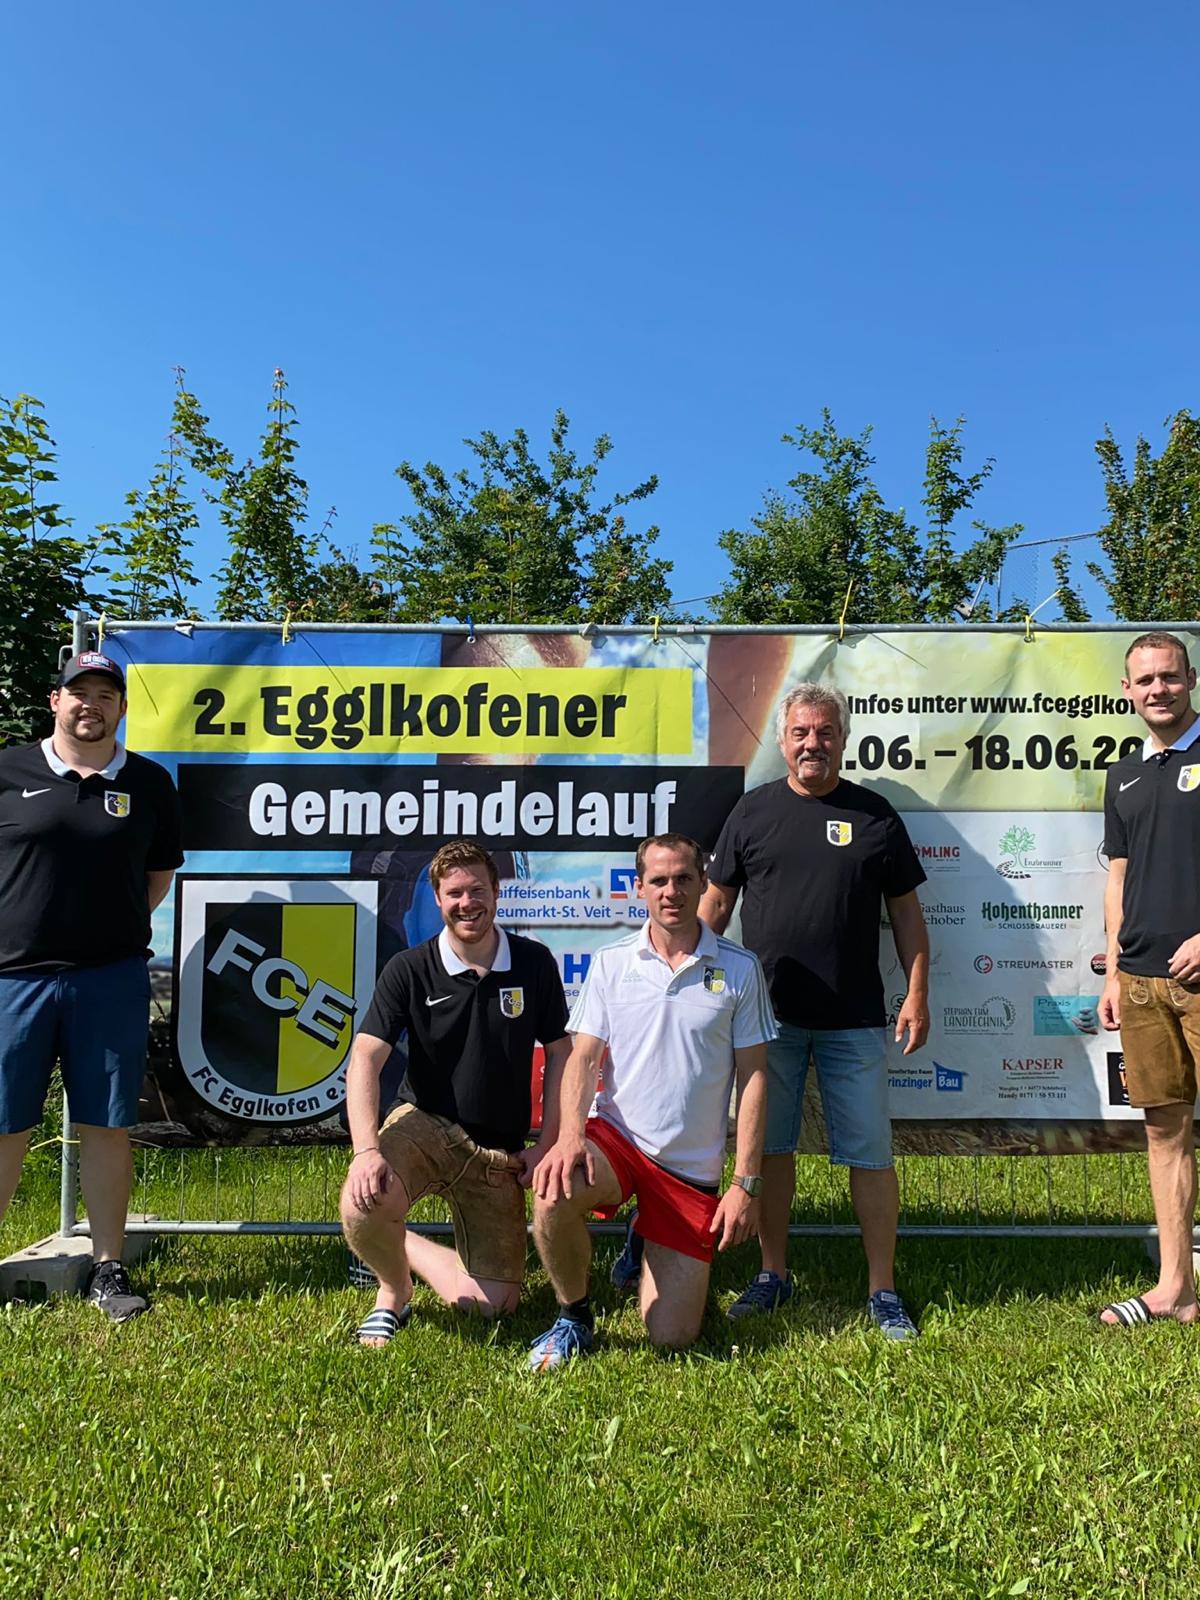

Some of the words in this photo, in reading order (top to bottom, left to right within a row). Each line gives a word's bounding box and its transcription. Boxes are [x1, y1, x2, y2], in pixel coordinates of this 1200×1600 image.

[847, 693, 904, 715] Infos
[908, 695, 968, 714] unter
[193, 688, 246, 736] 2.
[260, 683, 627, 750] Egglkofener
[839, 734, 927, 771] .06.
[964, 734, 1145, 771] 18.06.20
[249, 779, 677, 838] Gemeindelauf
[911, 843, 960, 859] ÖMLING
[498, 885, 591, 900] aiffeisenbank
[496, 905, 580, 919] eumarkt-St.
[584, 905, 611, 918] Veit
[628, 905, 650, 919] Rei
[981, 901, 1084, 922] Hohenthanner
[923, 914, 967, 926] chober
[997, 922, 1068, 930] SCHLOSSBRAUEREI
[996, 960, 1074, 969] STREUMASTER
[206, 927, 358, 1050] FCE
[1037, 998, 1072, 1007] Praxis
[943, 1016, 1006, 1028] LANDTECHNIK
[1001, 1058, 1064, 1071] KAPSER
[887, 1077, 933, 1090] rinzinger
[938, 1075, 959, 1089] Bau
[191, 1066, 219, 1094] FC
[217, 1086, 321, 1118] Egglkofen
